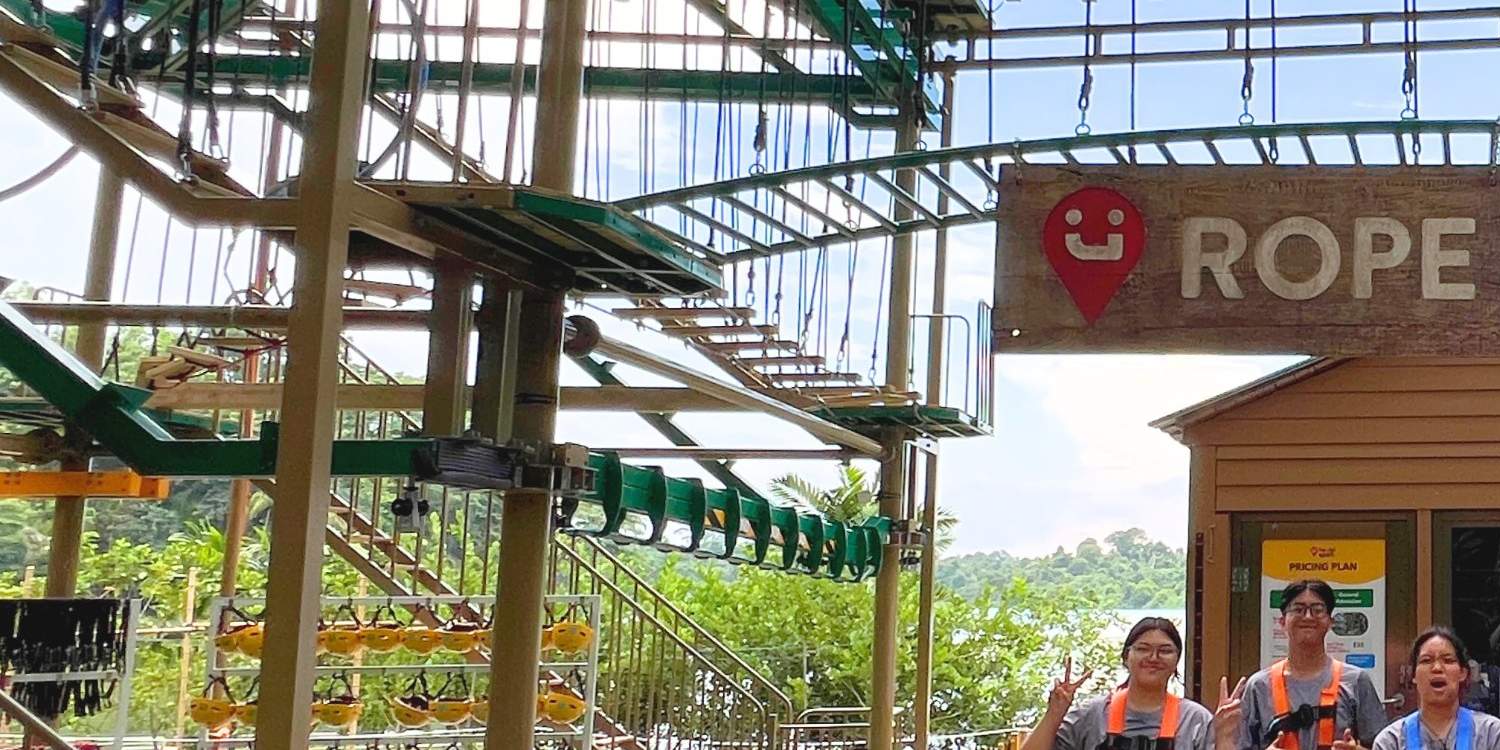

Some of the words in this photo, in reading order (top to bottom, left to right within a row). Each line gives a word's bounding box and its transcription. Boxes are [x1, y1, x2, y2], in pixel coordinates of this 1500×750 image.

[1181, 216, 1476, 300] ROPE
[1289, 562, 1329, 571] PRICING
[1331, 562, 1357, 571] PLAN
